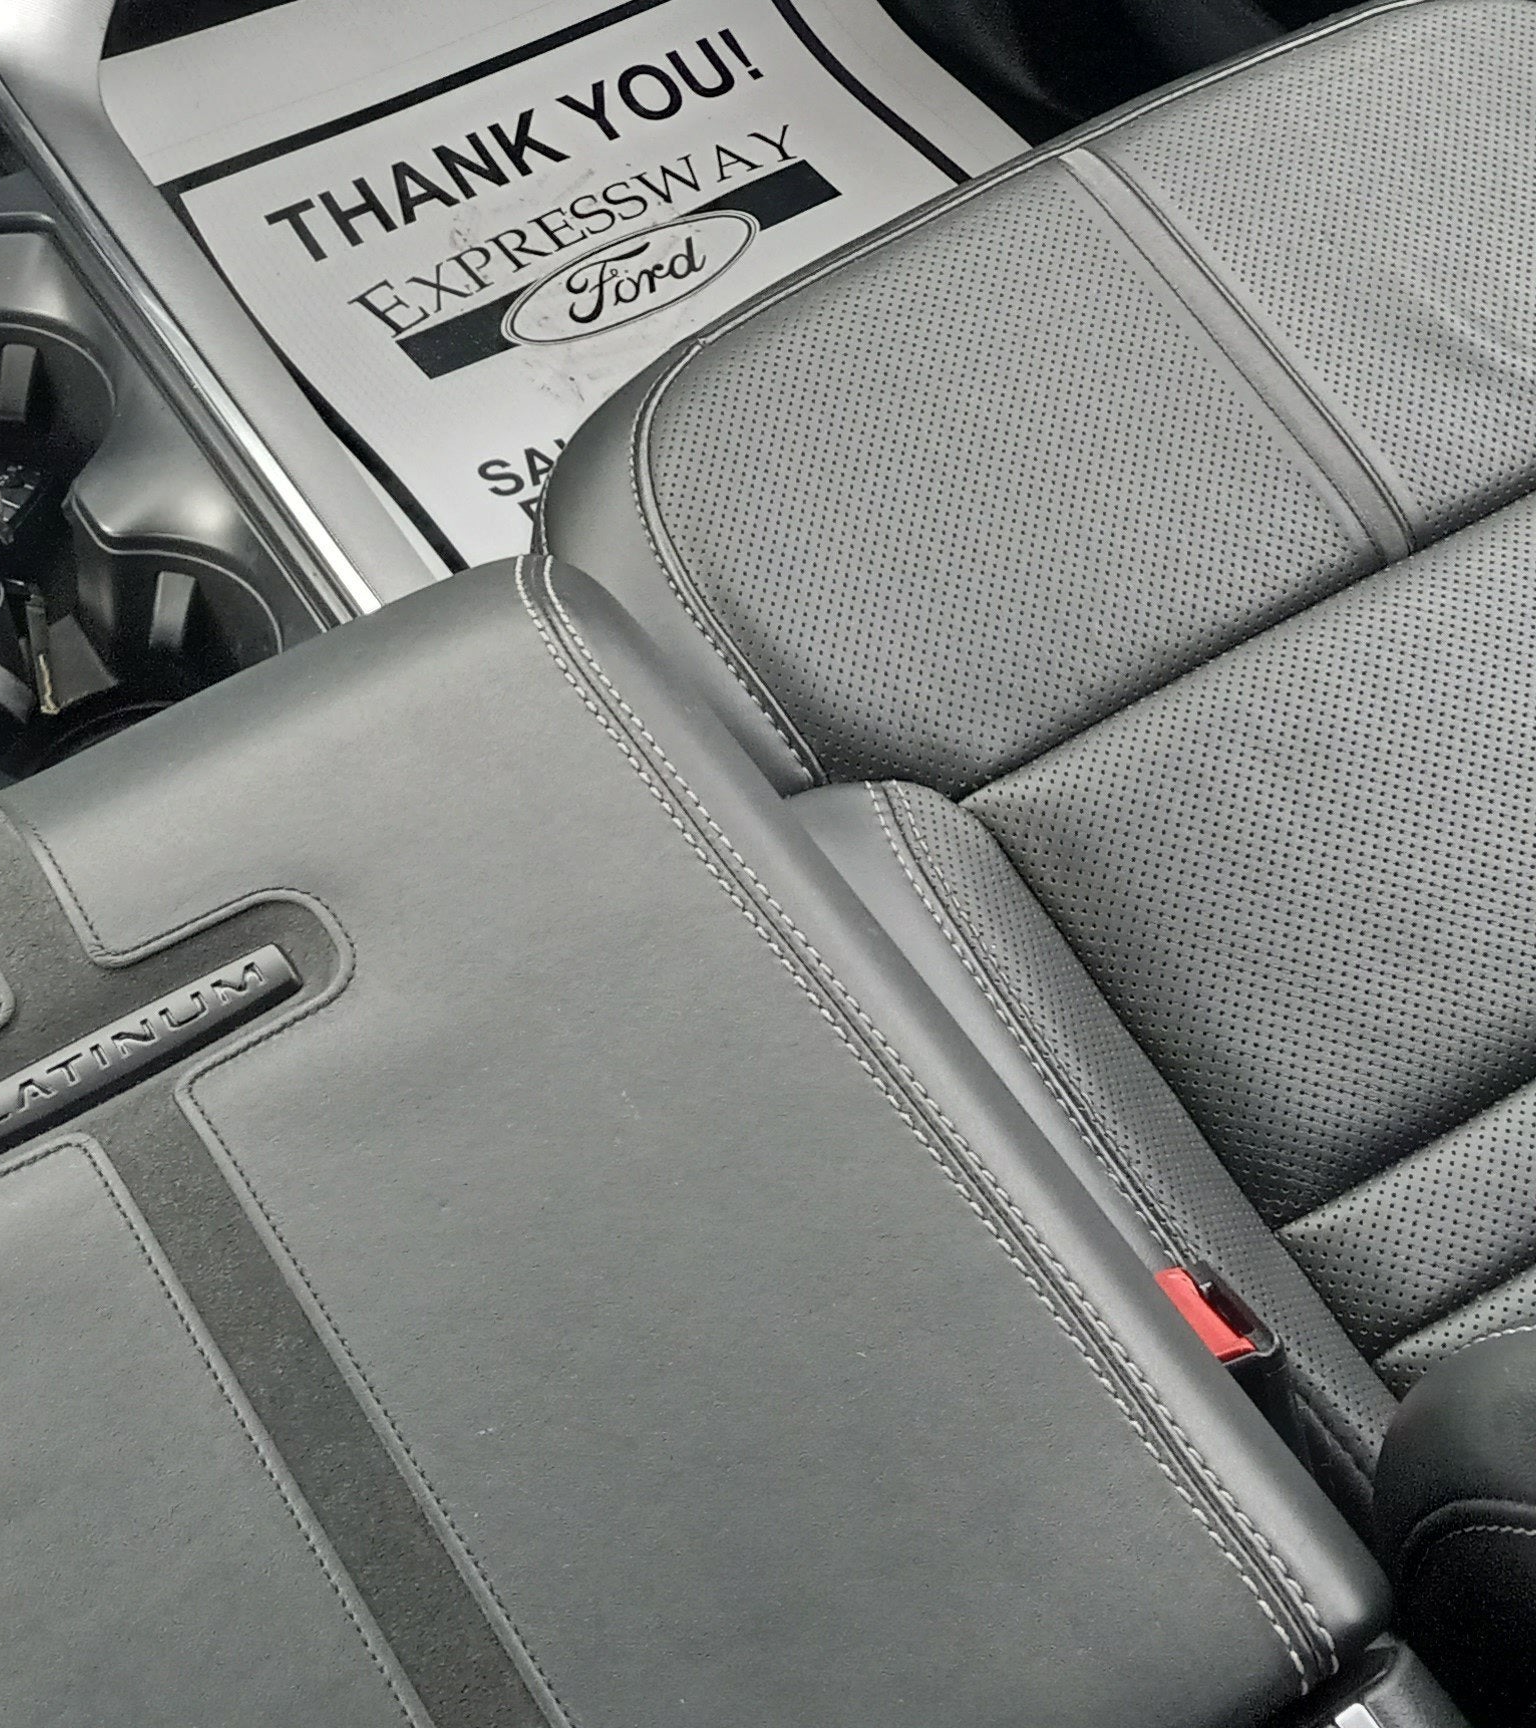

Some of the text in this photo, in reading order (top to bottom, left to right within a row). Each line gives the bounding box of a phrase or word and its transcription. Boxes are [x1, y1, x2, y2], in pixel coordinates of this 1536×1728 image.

[264, 28, 765, 263] THANK YOU!
[347, 124, 802, 339] EXPRESSWAY
[566, 236, 707, 324] Ford
[477, 438, 567, 497] SA
